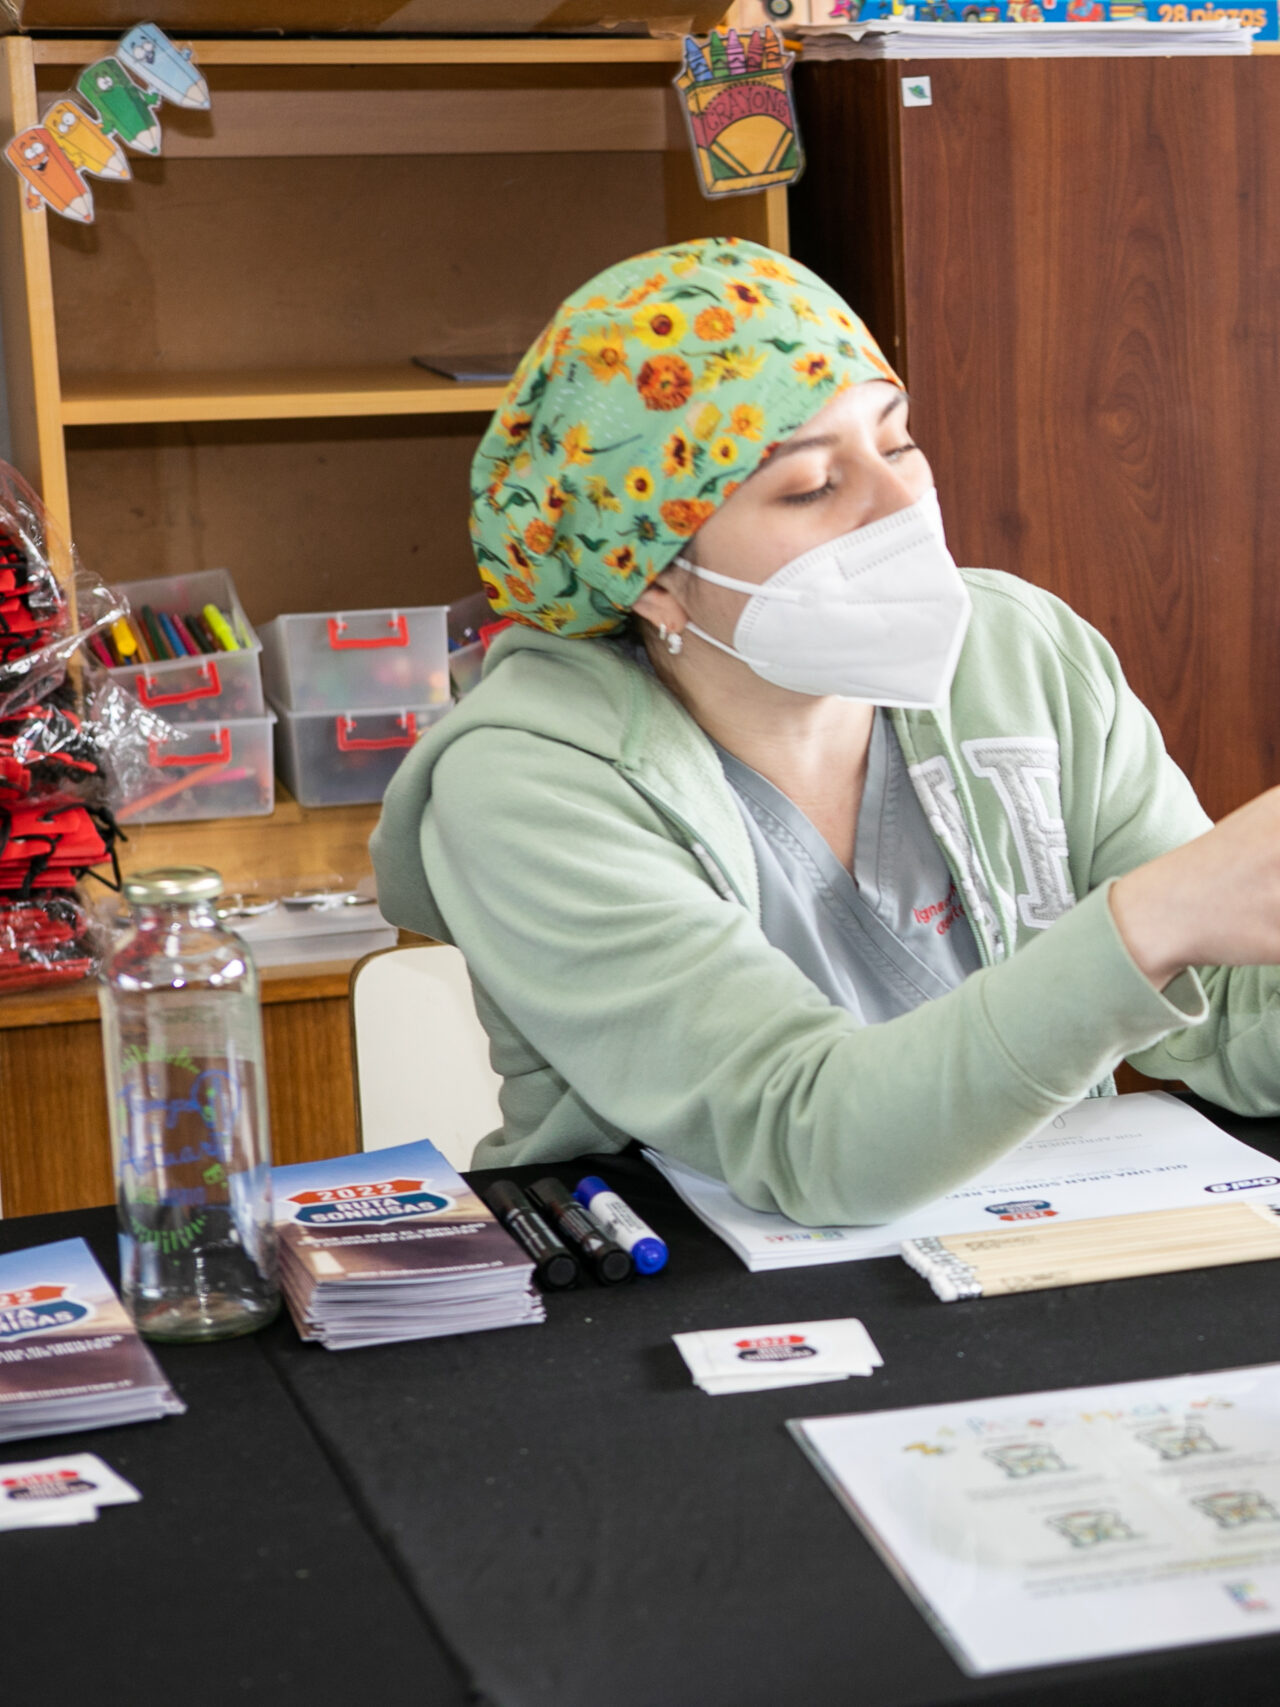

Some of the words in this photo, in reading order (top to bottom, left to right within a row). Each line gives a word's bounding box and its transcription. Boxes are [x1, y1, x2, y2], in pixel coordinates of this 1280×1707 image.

[1158, 4, 1187, 21] 28
[706, 87, 788, 131] CRAYONS
[317, 1182, 397, 1201] 2022
[985, 1181, 1061, 1195] SONRISA
[310, 1201, 437, 1223] SONRISAS
[337, 1197, 401, 1212] RUTA
